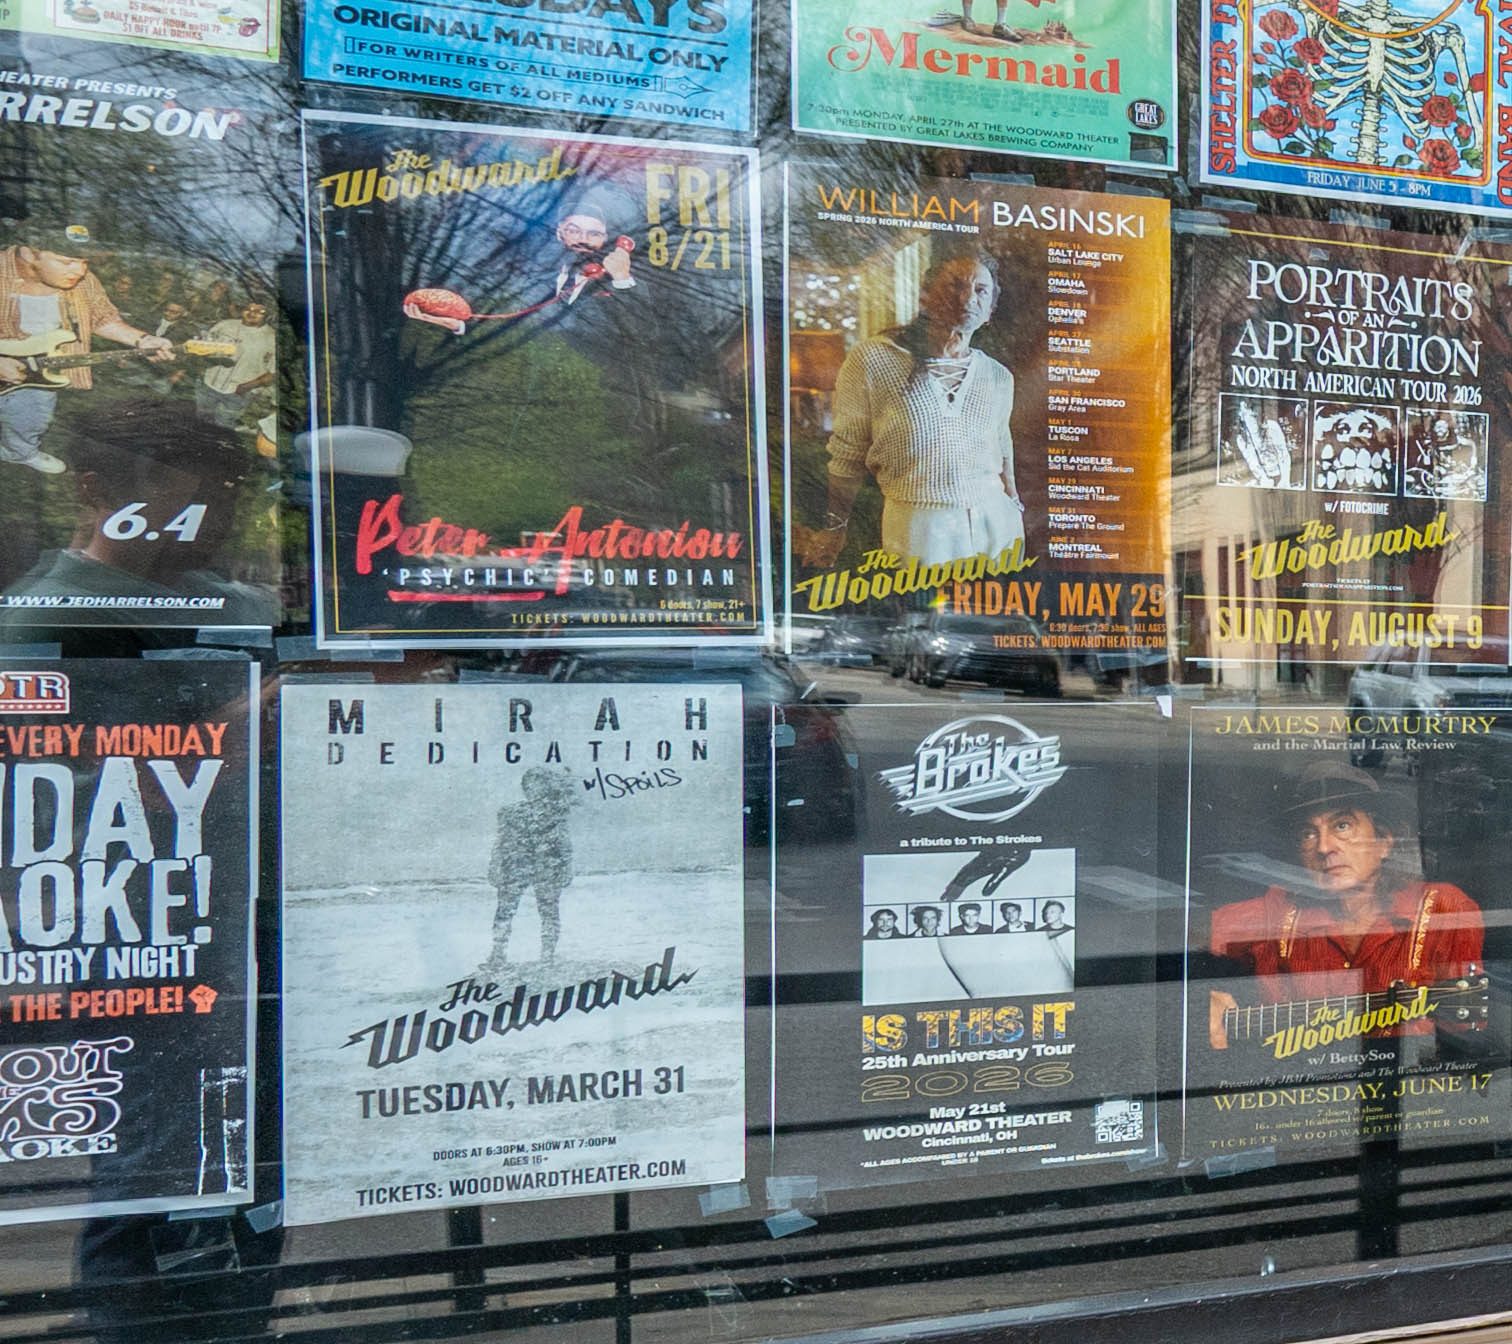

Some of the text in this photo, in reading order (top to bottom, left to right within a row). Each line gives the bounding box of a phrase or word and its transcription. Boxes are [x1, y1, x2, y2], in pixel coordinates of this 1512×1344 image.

[333, 5, 728, 72] ORIGINAL MATERIAL ONLY
[358, 42, 650, 87] FOR WRITERS OF ALL MEDIUMS
[827, 24, 1122, 96] Mermaid
[75, 78, 178, 100] PRESENTS
[332, 63, 725, 121] PERFORMERS GET $2 OFF ANY SANDWICH
[1209, 39, 1238, 174] SHELTER
[645, 163, 732, 228] FRI
[817, 184, 1145, 239] WILLIAM BASINSKI
[648, 230, 732, 271] 8/21
[1047, 277, 1086, 289] OMAHA
[1246, 259, 1474, 322] PORTRAITS
[1047, 307, 1087, 319] DENVER
[1047, 336, 1091, 348] SEATTLE
[1231, 318, 1482, 378] APPARITION
[1047, 366, 1100, 378] PORTLAND
[1230, 365, 1482, 406] NORTH AMERICAN TOUR 2026
[101, 502, 207, 543] 6.4
[356, 494, 745, 595] Peter Antoniou
[583, 568, 735, 587] COMEDIAN
[936, 582, 1168, 620] FRIDAY, MAY 29
[1214, 606, 1483, 650] SUNDAY, AUGUST 9
[328, 696, 707, 736] MIRAH
[1215, 715, 1497, 736] JAMES MCMURTRY
[96, 722, 229, 756] MONDAY
[328, 739, 709, 765] DEDICATION
[106, 944, 198, 980] NIGHT
[10, 986, 183, 1022] THE PEOPLE!
[862, 1043, 1075, 1070] 25th Anniversary Tour
[356, 1065, 686, 1120] TUESDAY, MARCH 31
[861, 1062, 1074, 1102] 2026
[1212, 1073, 1493, 1112] WEDNESDAY, JUNE 17
[863, 1111, 1072, 1141] WOODWARD THEATER
[929, 1102, 1006, 1120] May 21st
[922, 1130, 1017, 1148] Cincinnati, OH
[356, 1159, 687, 1207] TICKETS: WOODWARDTHEATER.COM
